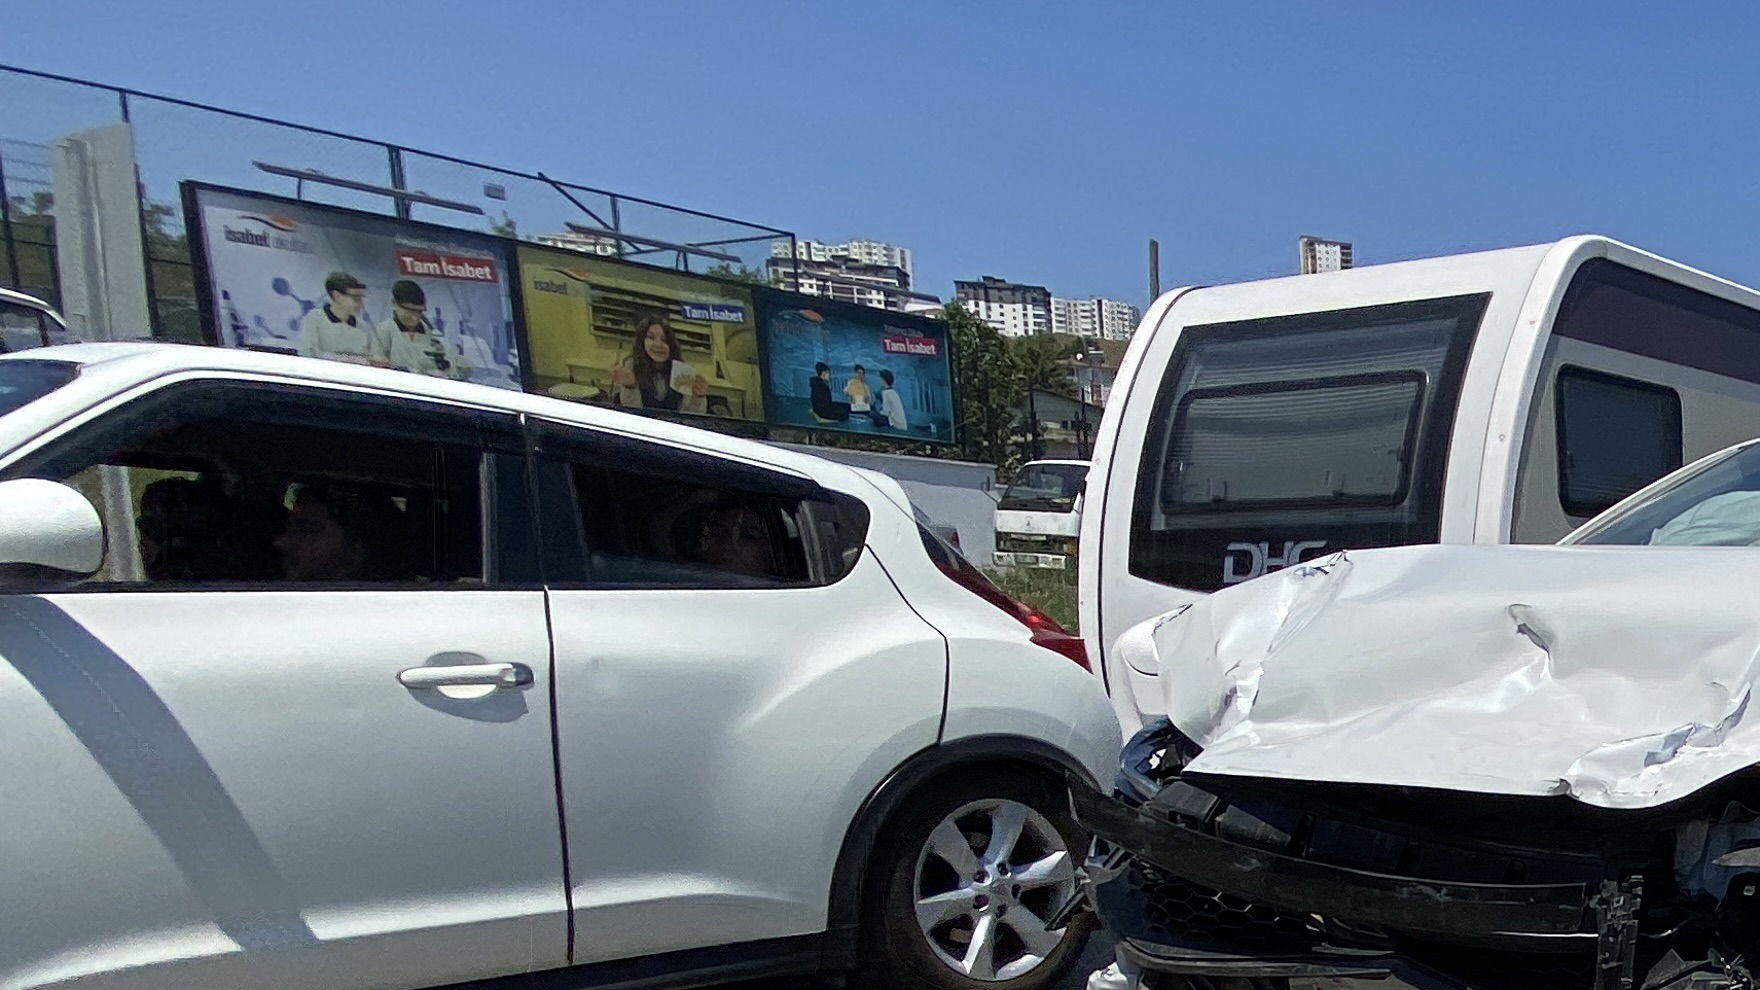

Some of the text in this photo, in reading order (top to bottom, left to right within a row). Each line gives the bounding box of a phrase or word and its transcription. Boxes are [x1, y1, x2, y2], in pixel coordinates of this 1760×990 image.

[401, 256, 440, 275] Tam
[683, 305, 709, 319] Tam
[883, 338, 906, 353] Tam
